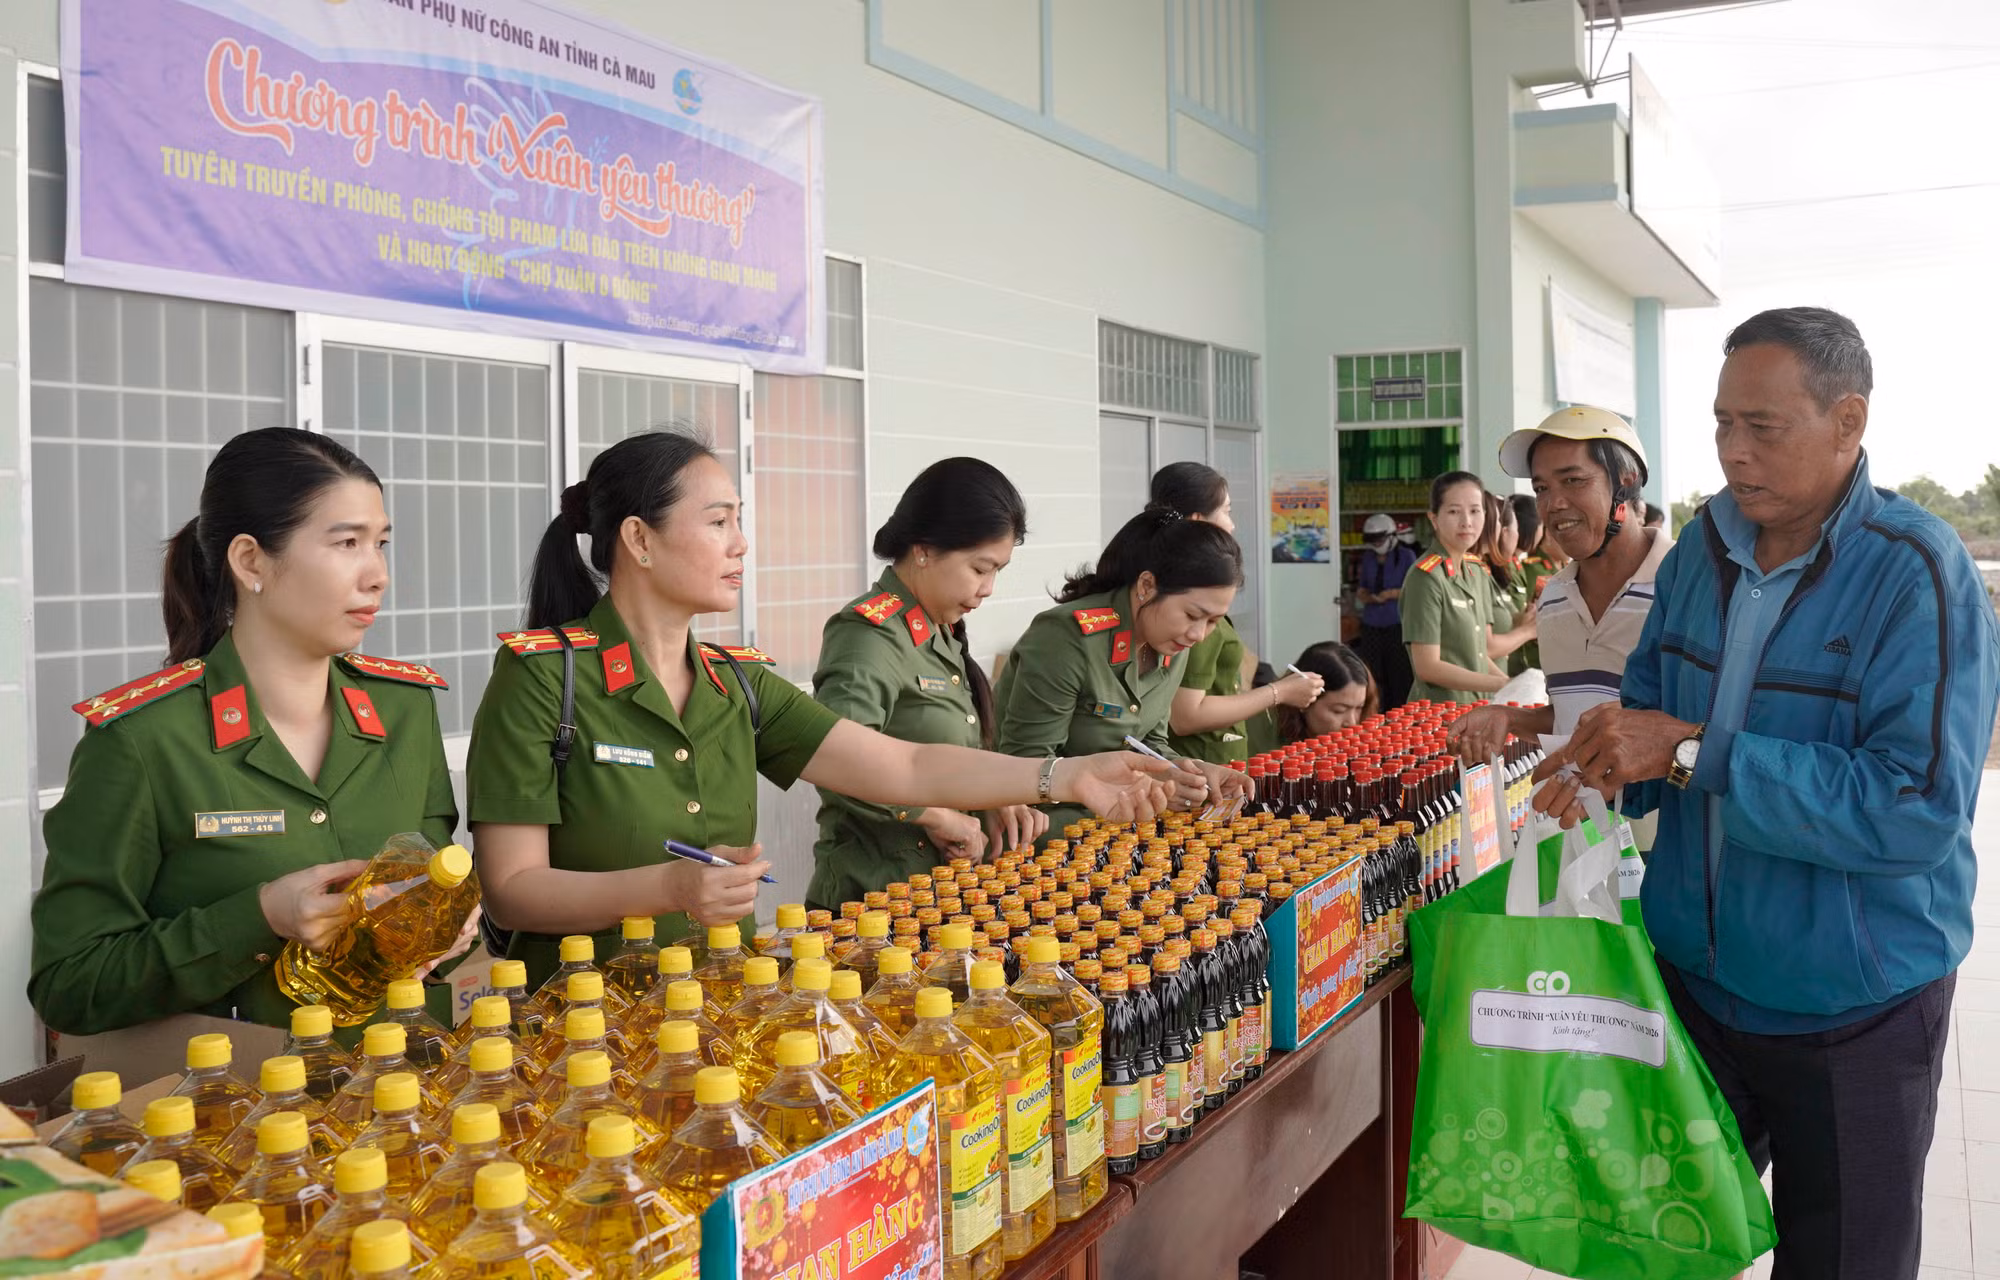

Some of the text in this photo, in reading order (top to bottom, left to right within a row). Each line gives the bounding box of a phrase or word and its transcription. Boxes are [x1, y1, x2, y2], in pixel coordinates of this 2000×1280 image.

[420, 0, 456, 28] PHỤ
[461, 9, 487, 34] NỮ
[489, 19, 534, 50] CÔNG
[538, 35, 560, 59] AN
[564, 41, 599, 72] TỈNH
[602, 56, 622, 79] CÀ
[624, 64, 656, 90] MAU
[205, 38, 381, 167] Chương
[383, 88, 484, 167] trình
[599, 152, 672, 238] yêu
[160, 145, 238, 189] TUYÊN
[243, 162, 327, 206] TRUYỀN
[333, 180, 407, 225] PHÒNG,
[412, 193, 475, 234] CHỐNG
[477, 207, 505, 245] TỘI
[509, 216, 558, 252] PHẠM
[622, 238, 661, 271] TRÊN
[662, 249, 708, 280] KHÔNG
[709, 258, 741, 286] GIAN
[377, 230, 403, 263] VÀ
[406, 238, 455, 275] HOẠT
[456, 246, 506, 281] ĐỘNG
[553, 264, 597, 295] XUÂN
[1627, 869, 1641, 877] 2026
[1304, 933, 1329, 974] GIAN
[1477, 1006, 1516, 1018] CHƯƠNG
[1517, 1009, 1544, 1021] TRÌNH
[1571, 1010, 1589, 1022] YÊU
[1645, 1026, 1659, 1038] 2026
[847, 1190, 925, 1274] HÀNG
